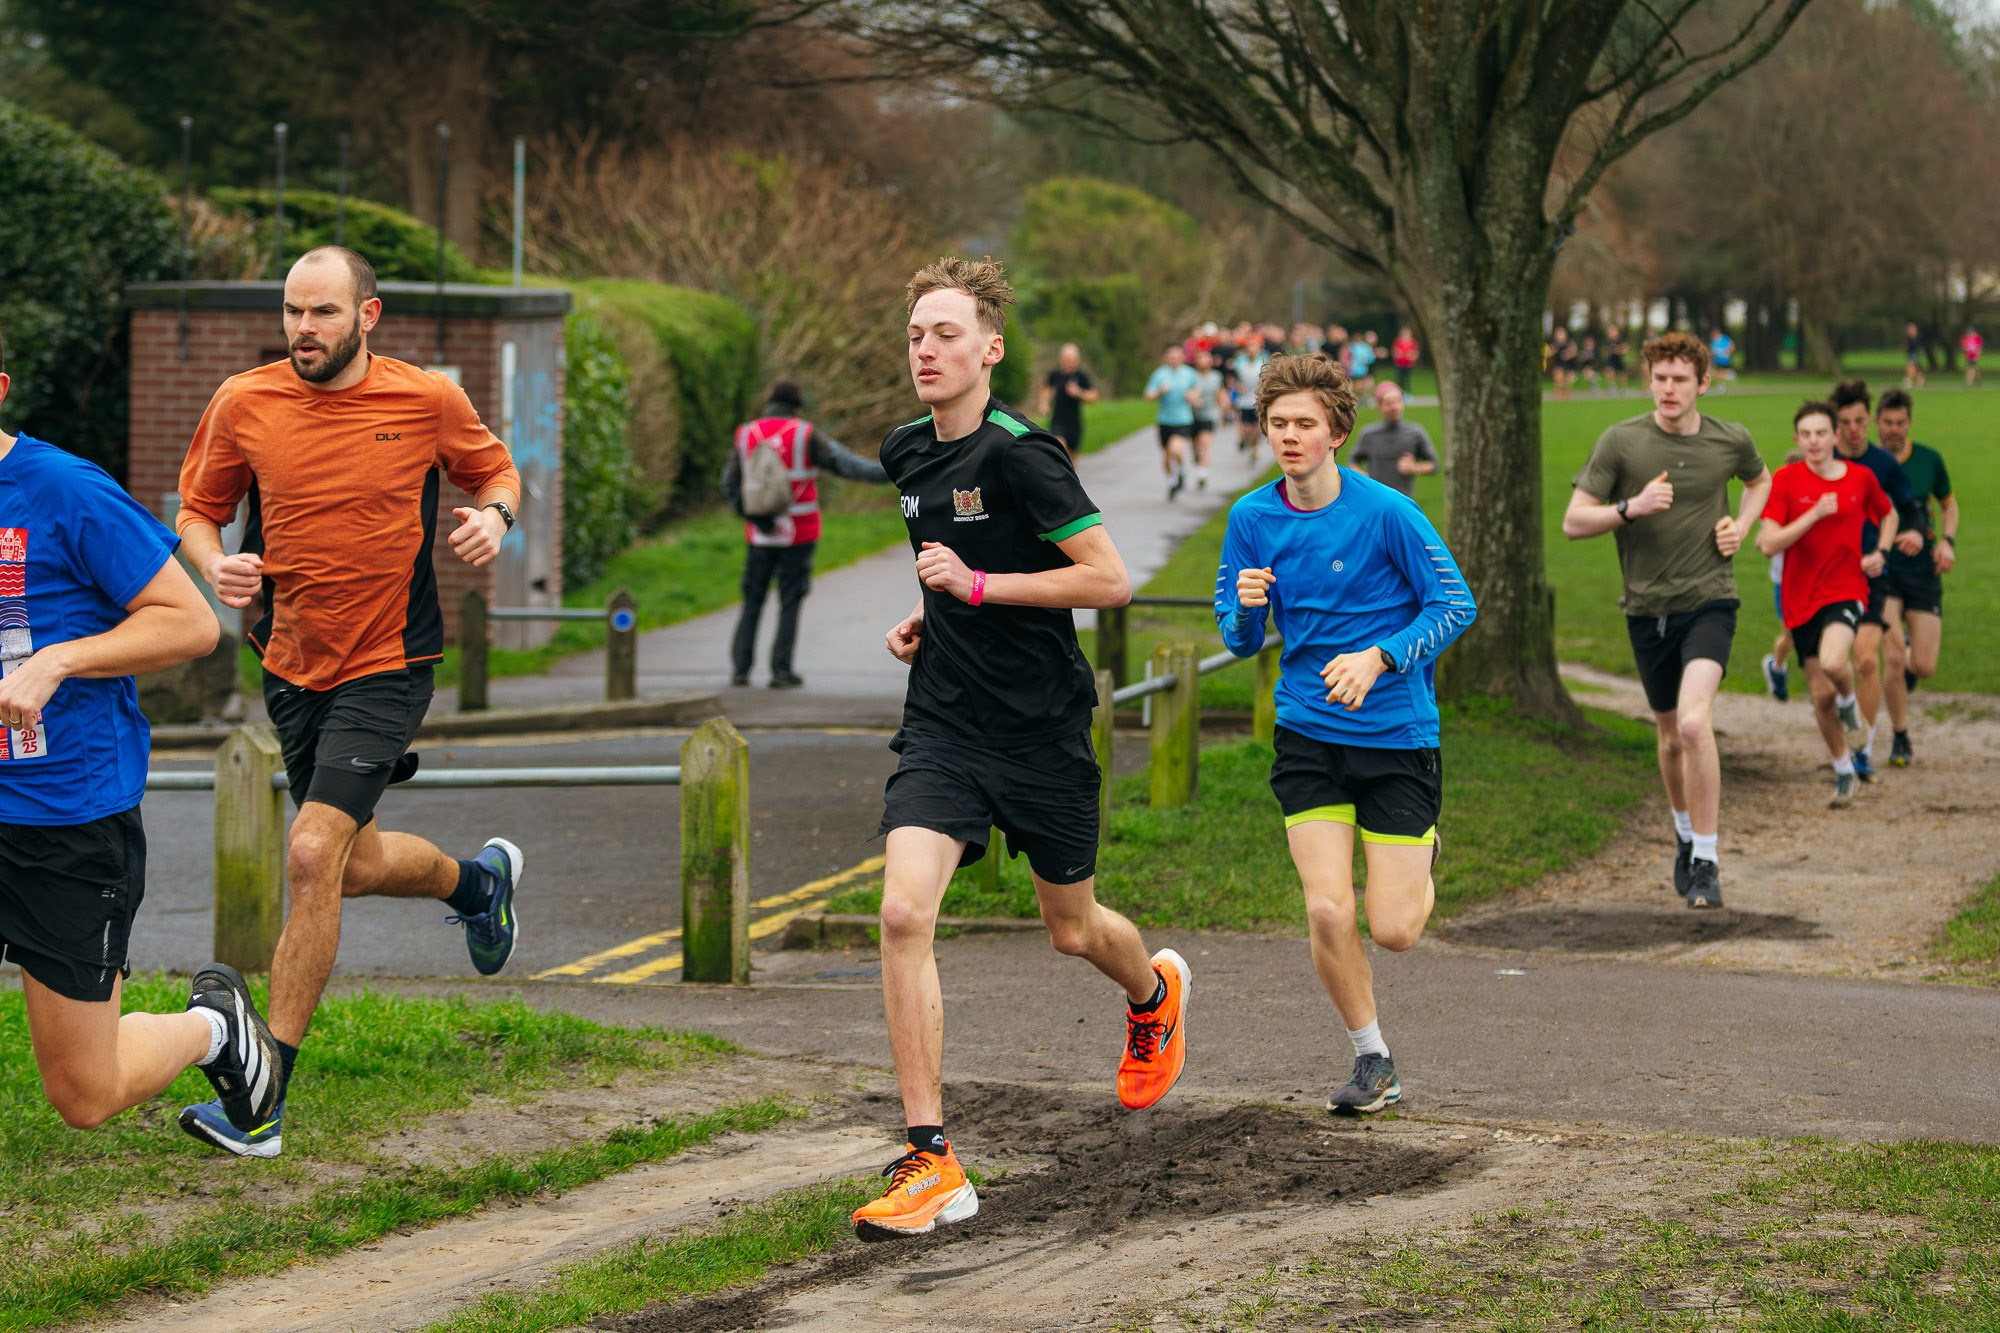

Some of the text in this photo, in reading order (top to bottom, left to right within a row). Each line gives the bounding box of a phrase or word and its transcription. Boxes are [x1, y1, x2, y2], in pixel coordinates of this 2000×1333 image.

[375, 433, 401, 441] DLX
[20, 729, 37, 742] 20
[22, 741, 38, 754] 25
